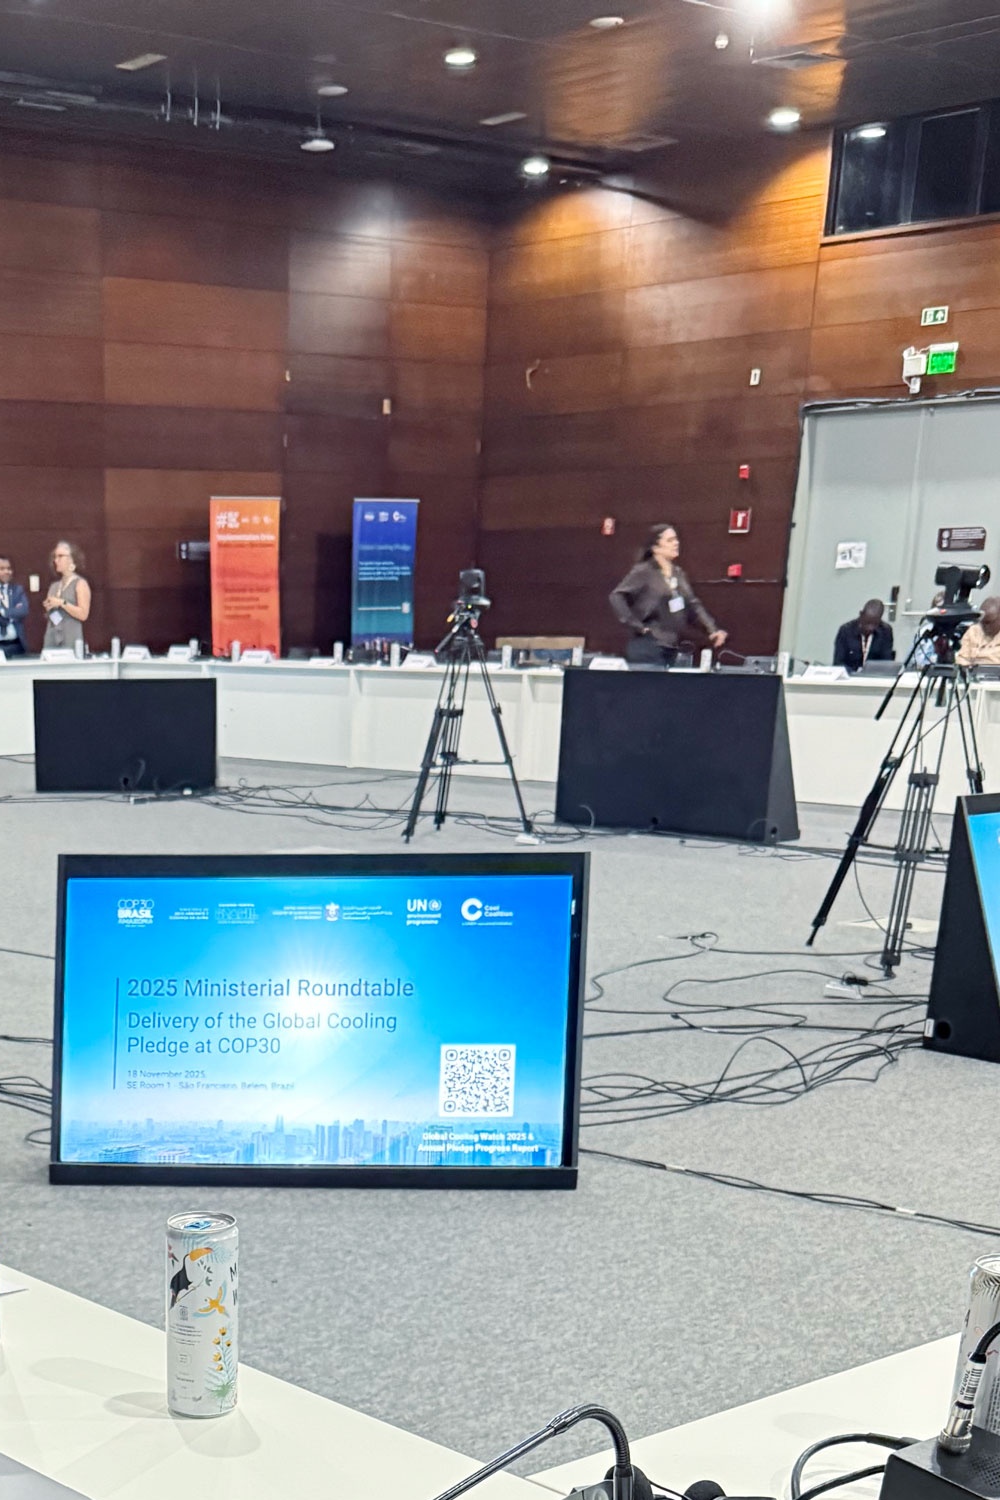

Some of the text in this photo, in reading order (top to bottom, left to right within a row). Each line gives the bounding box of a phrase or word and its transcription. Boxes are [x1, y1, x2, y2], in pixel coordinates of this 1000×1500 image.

[407, 899, 428, 912] UN
[118, 909, 153, 918] BRASIL
[127, 978, 414, 997] 2025 Ministerial Roundtable
[128, 1011, 397, 1033] Delivery of the Global Cooling
[127, 1036, 281, 1057] Pledge at COP30
[127, 1070, 138, 1078] 18
[140, 1069, 182, 1078] November
[126, 1081, 137, 1089] SE
[140, 1081, 165, 1089] Room
[423, 1132, 448, 1141] Global
[480, 1132, 505, 1141] Watch
[507, 1132, 526, 1141] 2025
